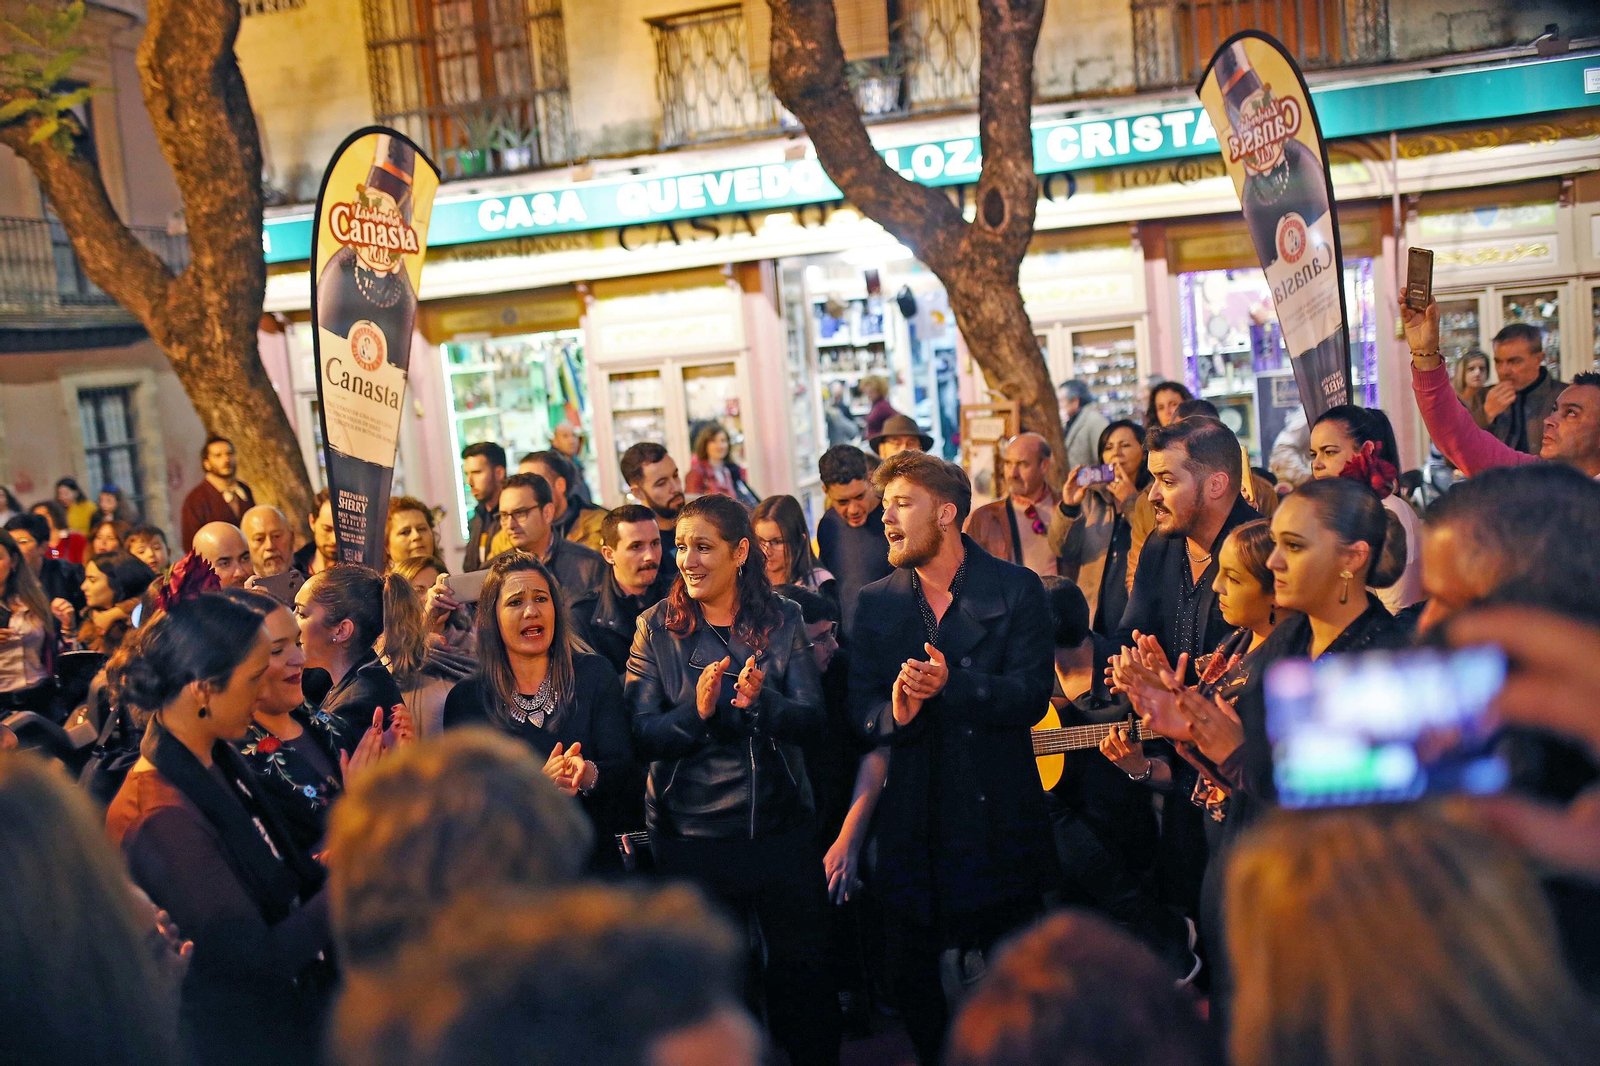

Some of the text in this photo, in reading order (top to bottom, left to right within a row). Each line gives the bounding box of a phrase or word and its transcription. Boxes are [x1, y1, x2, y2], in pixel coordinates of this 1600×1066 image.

[478, 190, 588, 232] CASA
[616, 159, 825, 218] QUEVEDO
[330, 204, 419, 253] Canasta
[325, 357, 399, 411] Canasta
[338, 497, 368, 514] SHERRY
